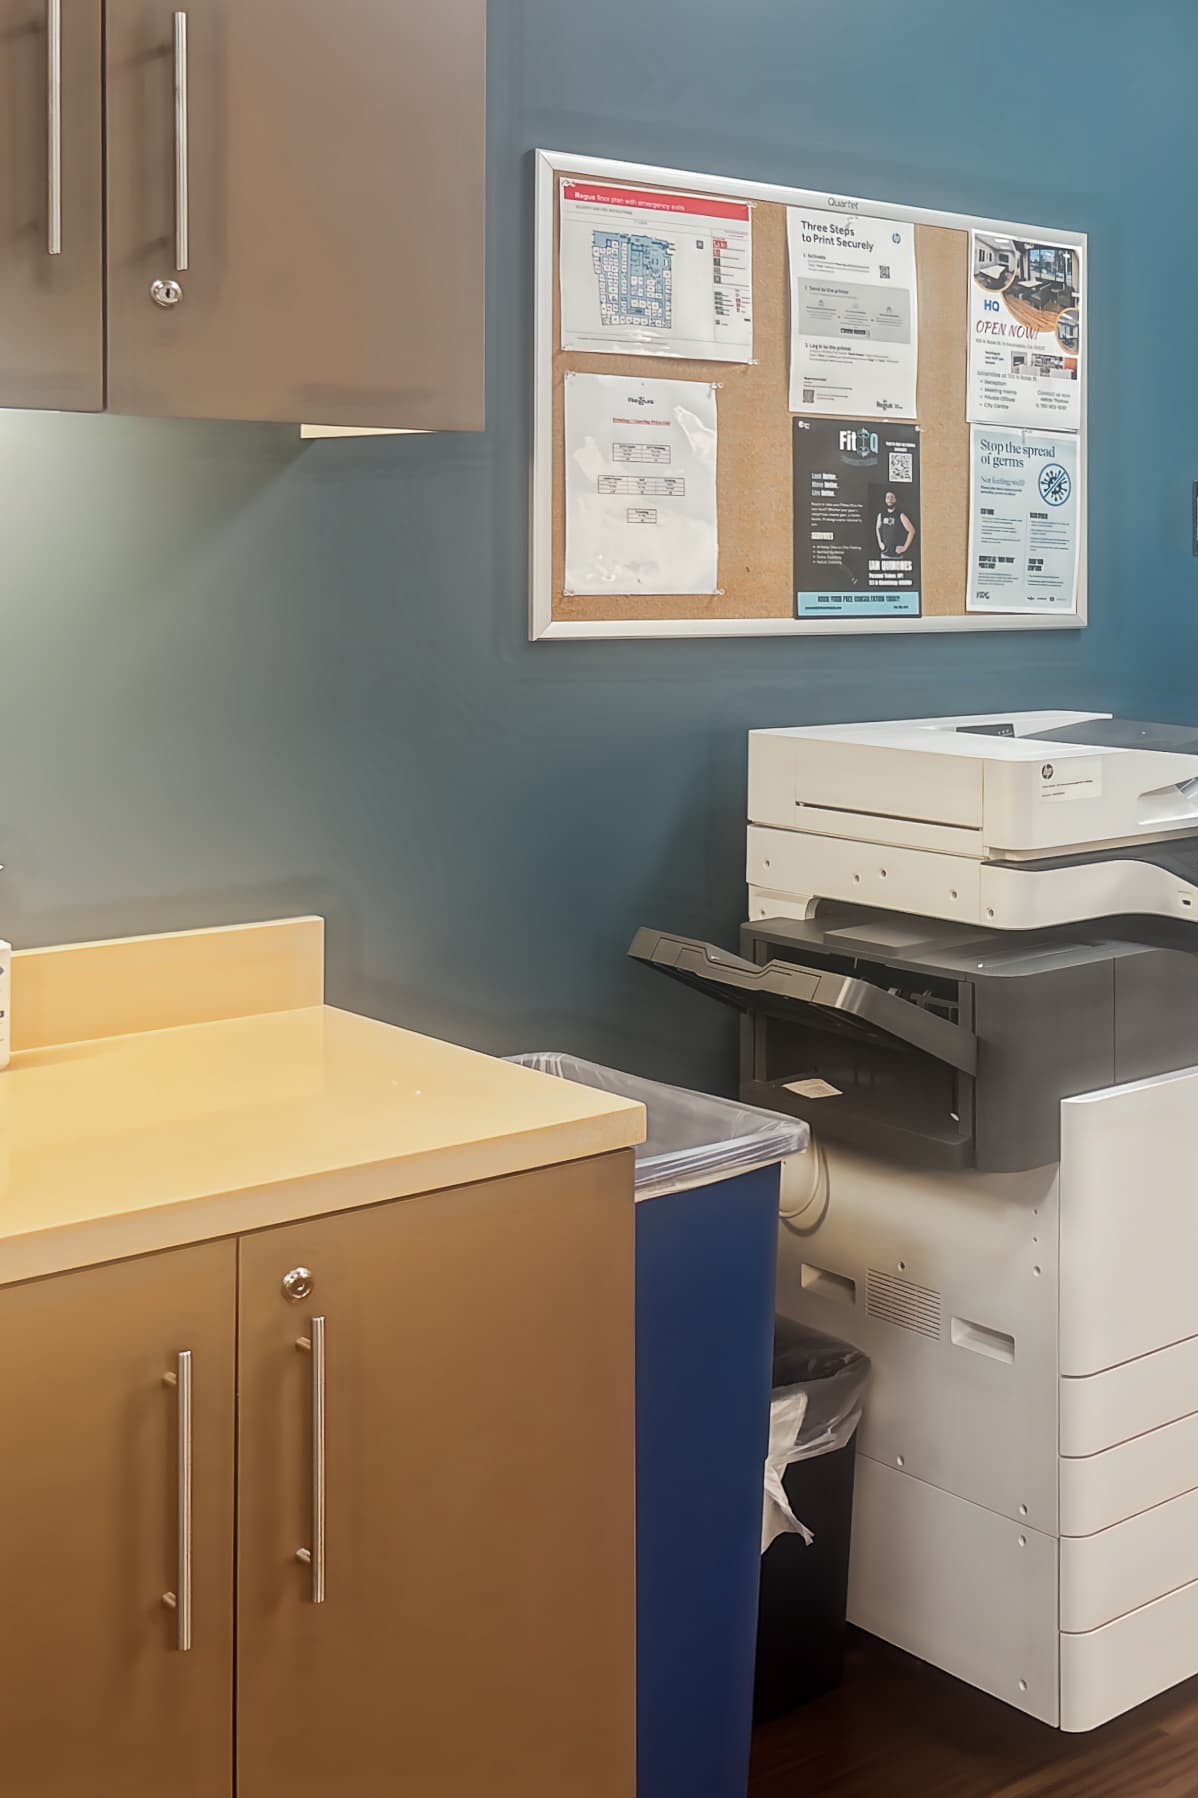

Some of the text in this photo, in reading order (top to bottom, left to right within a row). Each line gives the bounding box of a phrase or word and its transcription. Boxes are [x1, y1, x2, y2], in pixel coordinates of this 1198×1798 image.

[827, 197, 859, 211] Quartet
[801, 220, 855, 237] Three Steps
[802, 234, 874, 253] to Print Securely
[984, 300, 1000, 312] HQ
[976, 320, 1040, 340] OPEN NOW!
[839, 430, 858, 452] Fit
[980, 439, 1056, 459] Stop the spread
[980, 452, 1024, 468] of germs
